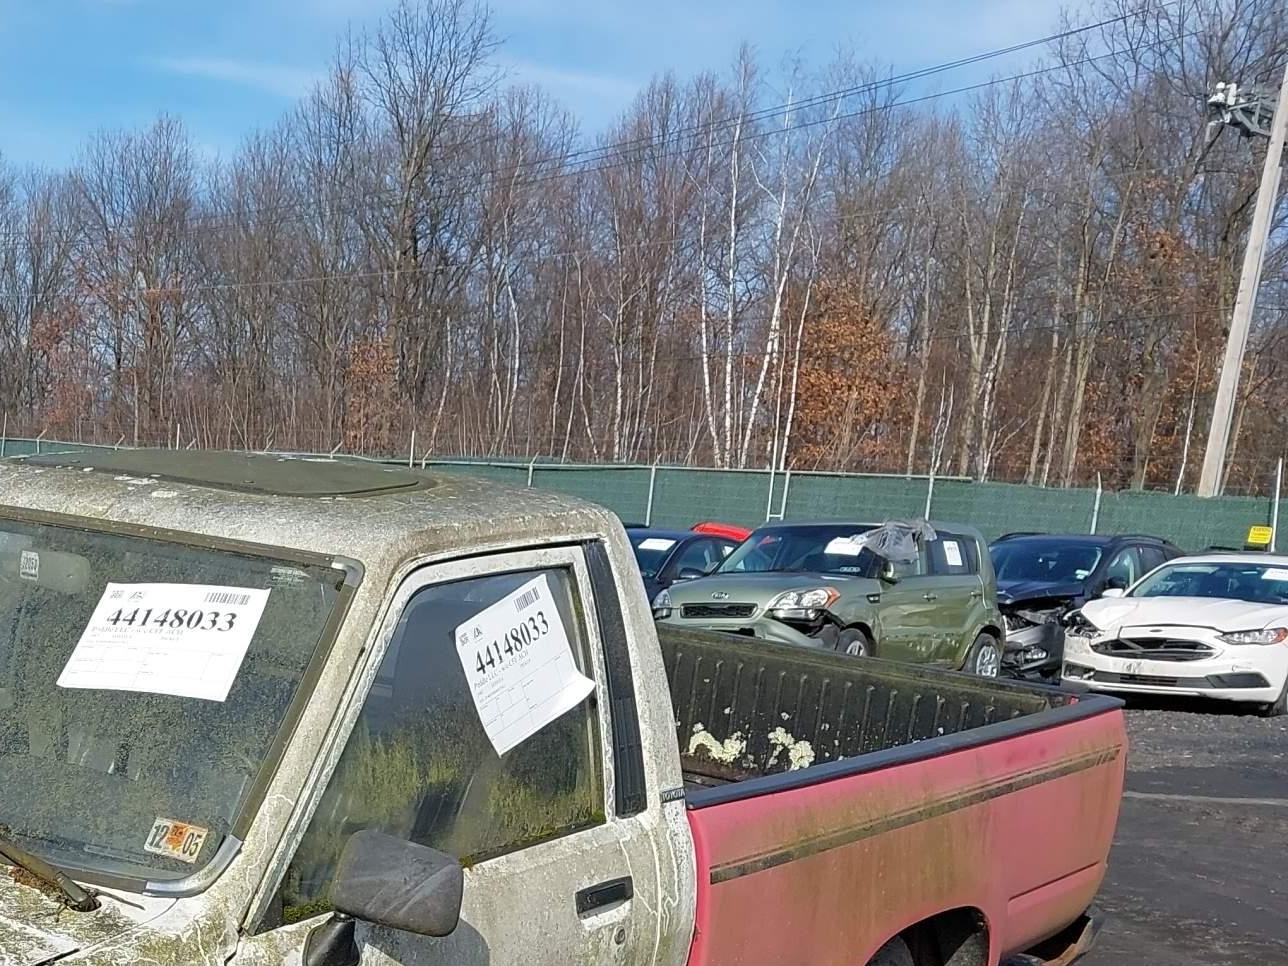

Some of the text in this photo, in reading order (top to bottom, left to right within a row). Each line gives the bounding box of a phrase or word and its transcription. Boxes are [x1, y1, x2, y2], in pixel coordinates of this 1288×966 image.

[107, 607, 237, 632] 44148033
[474, 610, 549, 675] 44148033
[148, 825, 170, 849] 12
[182, 832, 202, 857] 05
